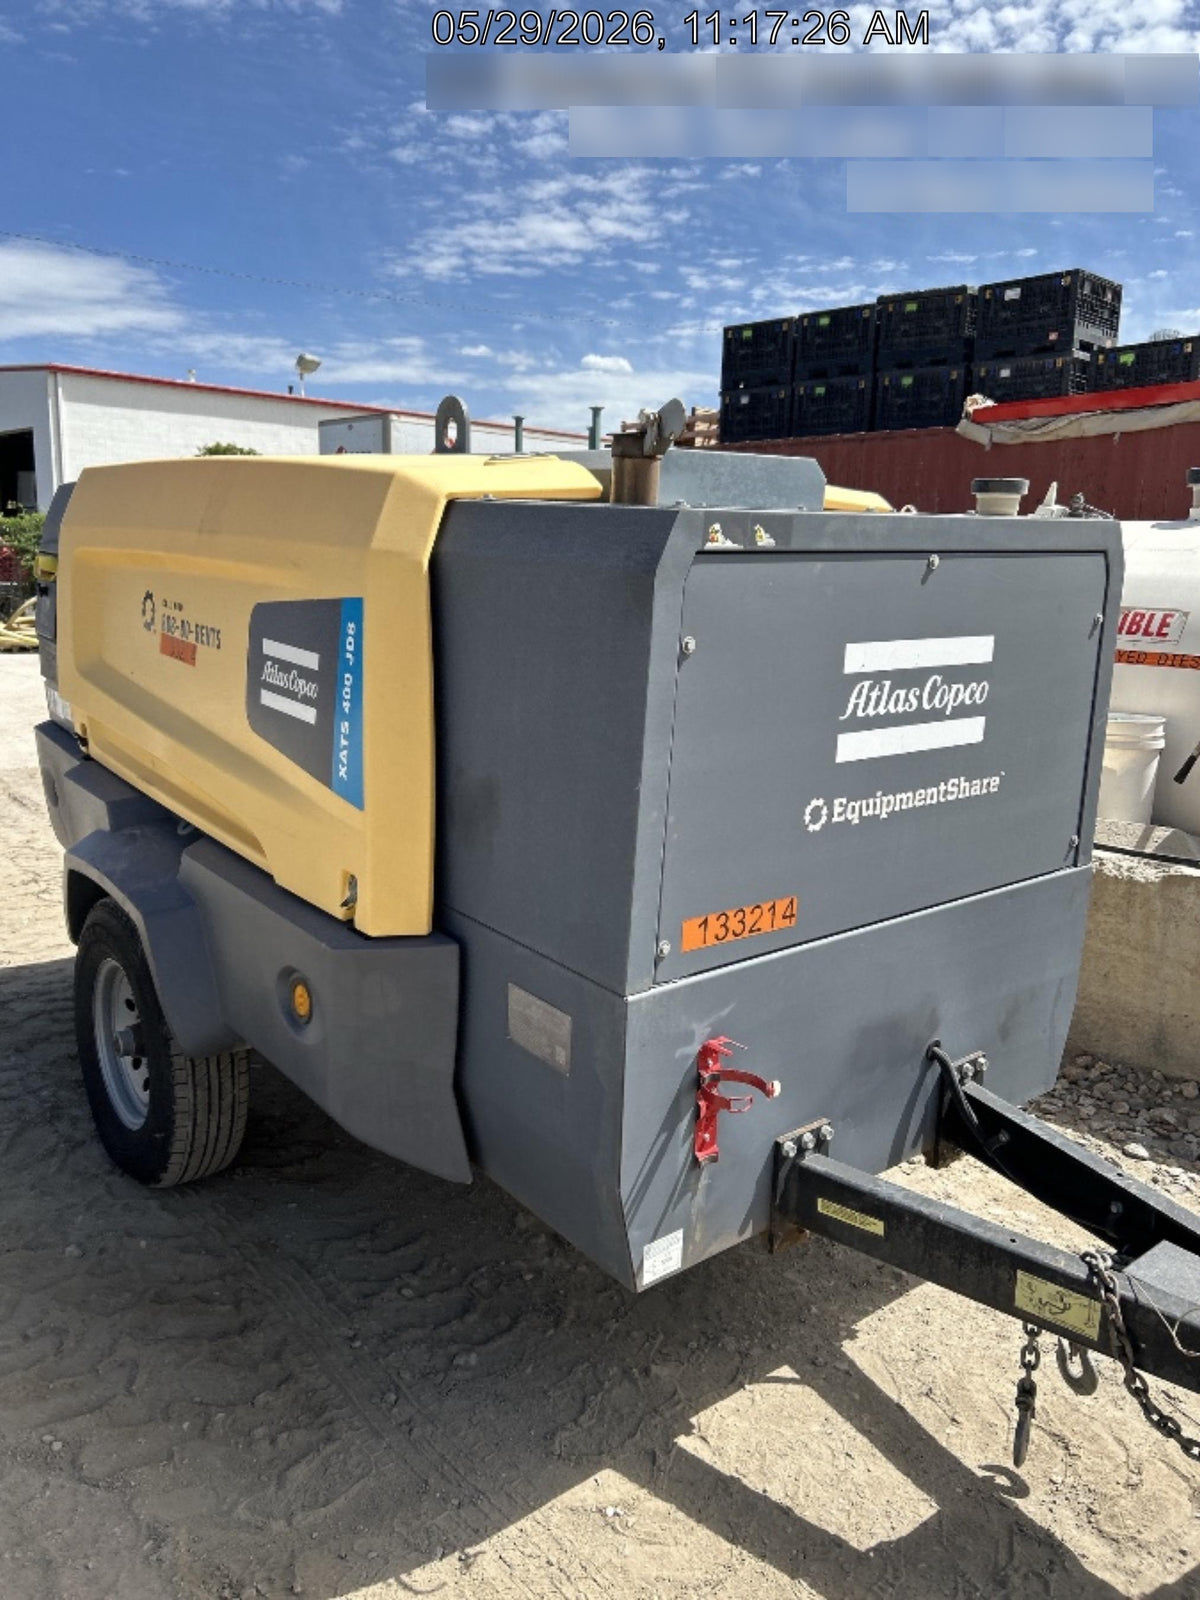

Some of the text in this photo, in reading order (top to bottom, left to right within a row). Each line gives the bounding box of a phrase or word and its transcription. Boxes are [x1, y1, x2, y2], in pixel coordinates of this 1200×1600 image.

[261, 661, 319, 699] Atlas Copco
[342, 673, 353, 715] 400
[839, 675, 990, 720] Atlas Copco
[338, 721, 350, 781] XATS
[831, 774, 1000, 826] EquipmentShare
[698, 897, 796, 945] 133214
